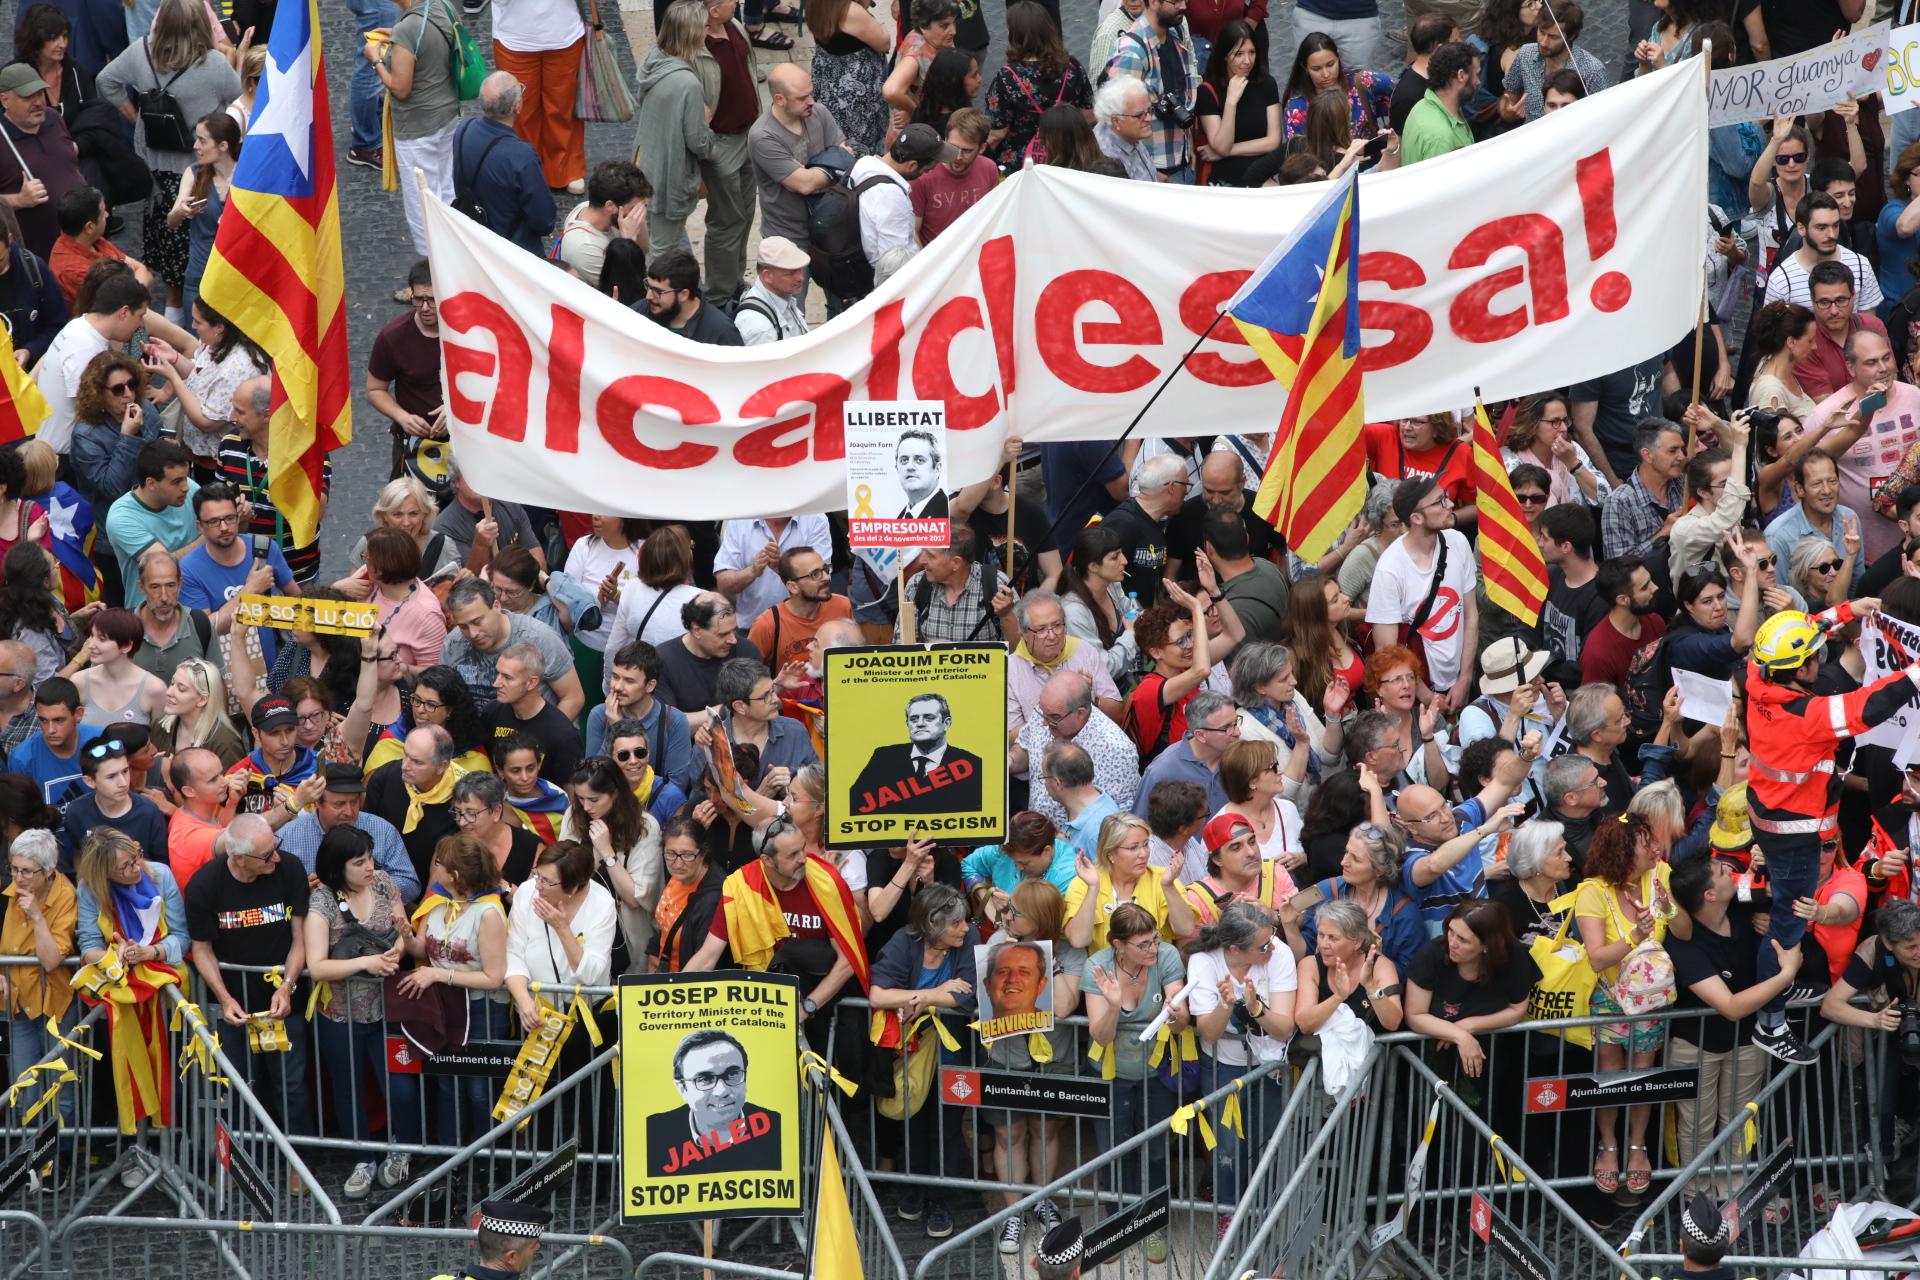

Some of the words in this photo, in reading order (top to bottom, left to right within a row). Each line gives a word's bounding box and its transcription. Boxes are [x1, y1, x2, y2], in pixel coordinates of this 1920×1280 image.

[1774, 48, 1860, 99] guanya
[848, 412, 942, 426] LLIBERTAT
[852, 522, 946, 534] EMPRESONAT
[844, 655, 932, 669] JOAQUIM
[938, 653, 990, 665] FORN
[858, 758, 974, 814] JAILED
[840, 819, 896, 834] STOP
[904, 816, 997, 831] FASCISM
[638, 987, 718, 1007] JOSEP
[727, 986, 788, 1006] RULL
[642, 1011, 695, 1020] Territory
[699, 1007, 747, 1018] Minister
[750, 1008, 762, 1016] of
[766, 1009, 784, 1018] the
[639, 1021, 711, 1031] Government
[715, 1018, 727, 1027] of
[731, 1017, 786, 1029] Catalonia
[981, 1011, 1054, 1039] BENVINGUT
[429, 1055, 487, 1065] Ajuntament
[984, 1084, 1040, 1098] Ajuntament
[1043, 1089, 1055, 1098] de
[1058, 1091, 1107, 1104] Barcelona
[1570, 1085, 1627, 1098] Ajuntament
[1645, 1080, 1694, 1091] Barcelona
[662, 1112, 772, 1173] JAILED
[543, 1159, 574, 1184] Barcelona
[631, 1183, 690, 1207] STOP
[697, 1178, 795, 1203] FASCISM
[1084, 1228, 1124, 1259] Ajuntament
[1124, 1224, 1133, 1235] de
[1133, 1206, 1167, 1230] Barcelona
